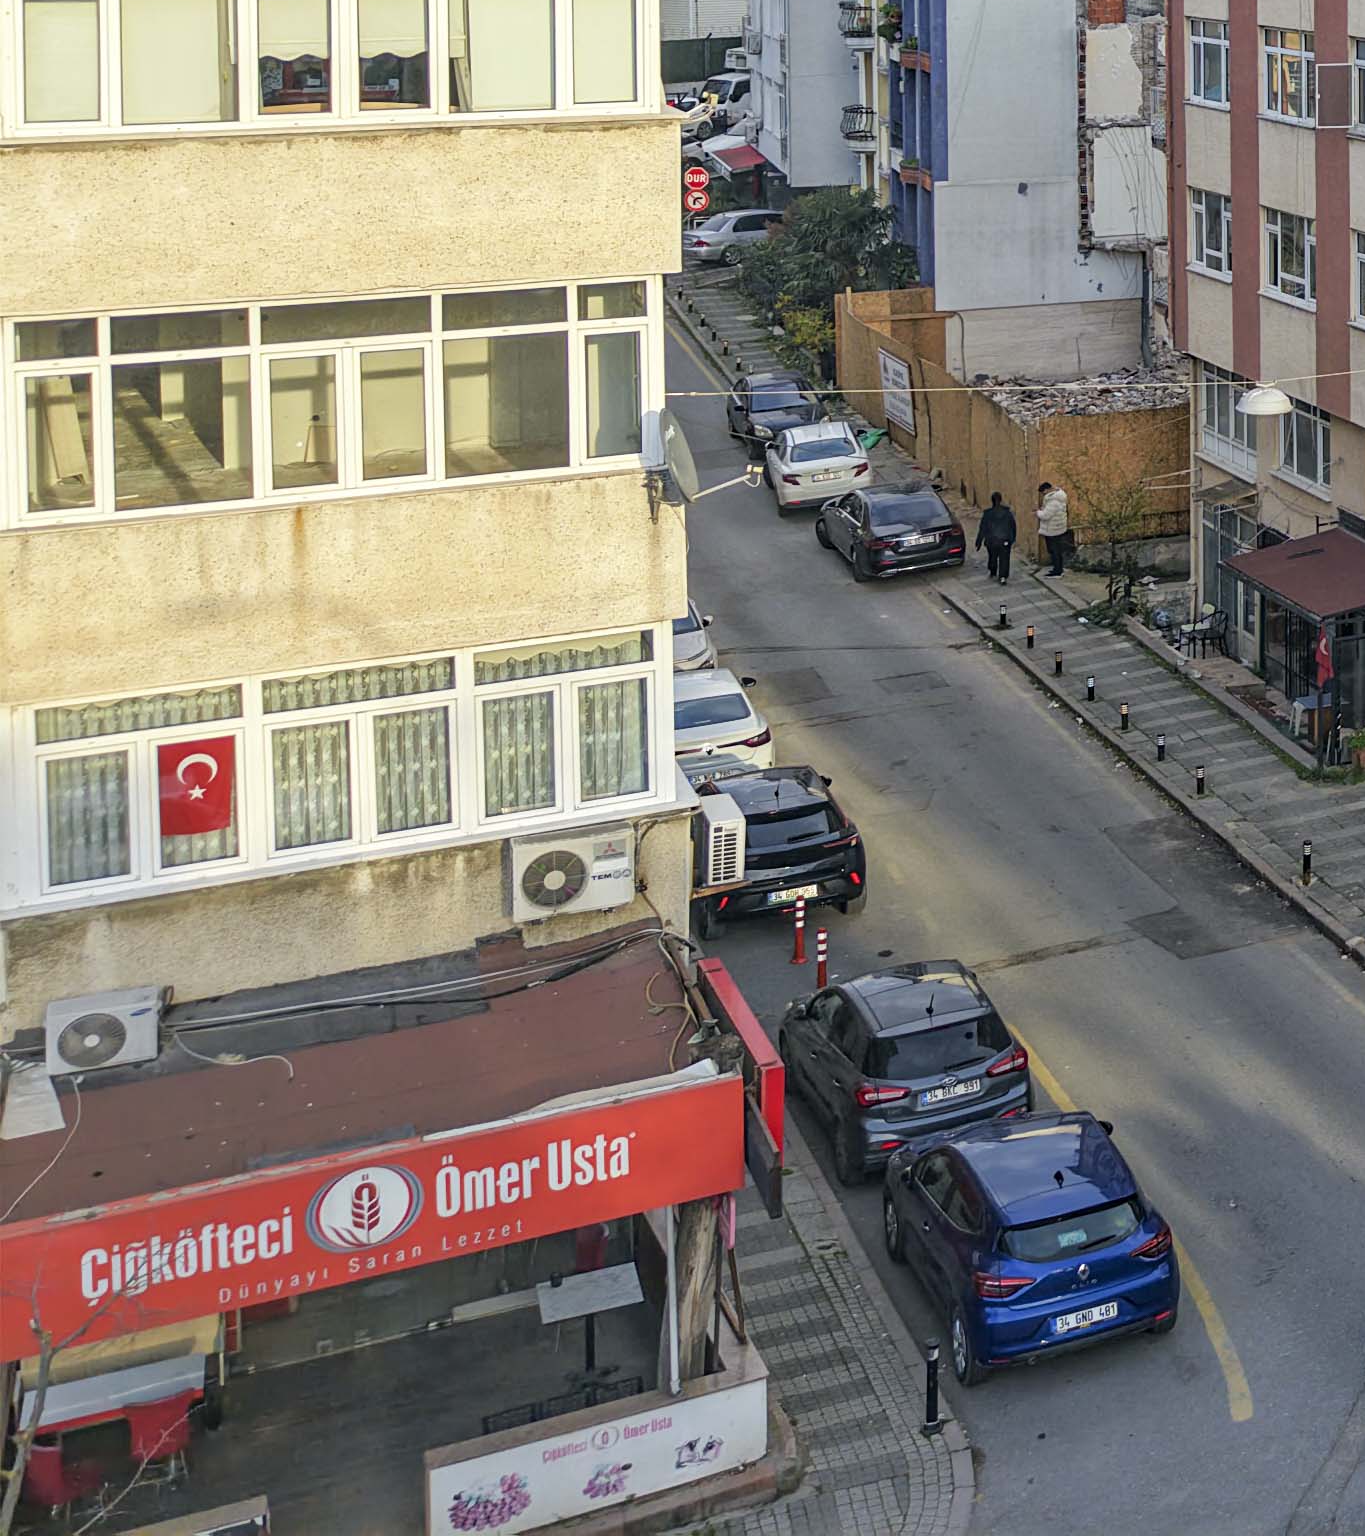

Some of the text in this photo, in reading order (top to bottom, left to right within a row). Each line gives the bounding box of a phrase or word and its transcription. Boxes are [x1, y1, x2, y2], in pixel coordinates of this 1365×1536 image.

[687, 174, 706, 183] DUR
[928, 1090, 939, 1101] 34
[81, 1133, 631, 1308] Çiğköfteci Ömer Usta
[218, 1218, 525, 1305] Dünyayı Saran Lezzet
[1058, 1317, 1070, 1330] 34
[1075, 1309, 1094, 1325] GND
[650, 1415, 673, 1433] Usta
